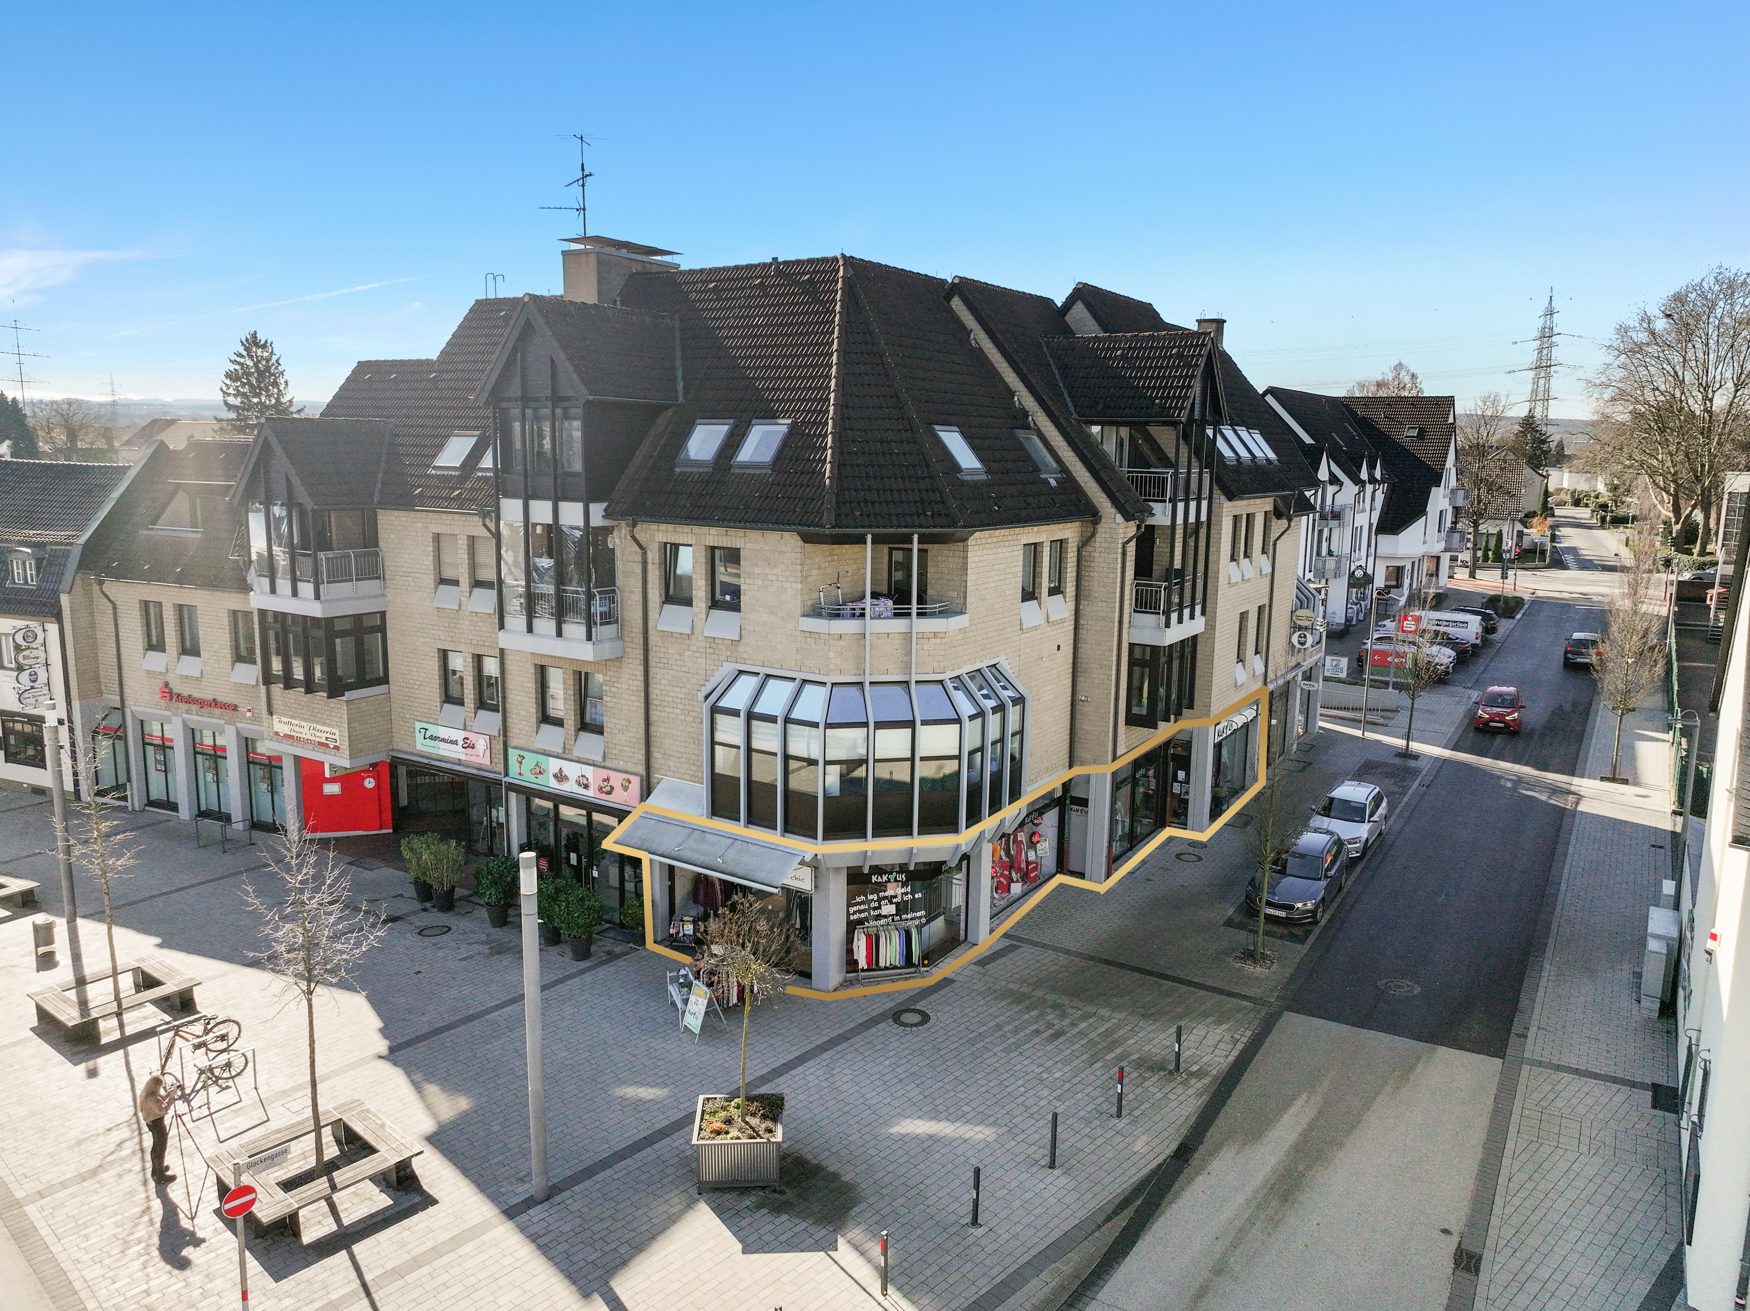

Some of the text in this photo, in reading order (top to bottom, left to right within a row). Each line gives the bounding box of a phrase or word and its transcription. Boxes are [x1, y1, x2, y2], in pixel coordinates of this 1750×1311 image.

[174, 693, 236, 712] Kreissparkasse
[276, 716, 337, 737] Trattoria Pizzeria
[419, 727, 459, 746] Taormina
[461, 737, 476, 750] Eis
[896, 885, 911, 894] Geld
[848, 904, 868, 913] genau
[902, 910, 926, 920] meinem
[850, 912, 869, 920] sehen
[246, 1147, 288, 1170] Glockengasse
